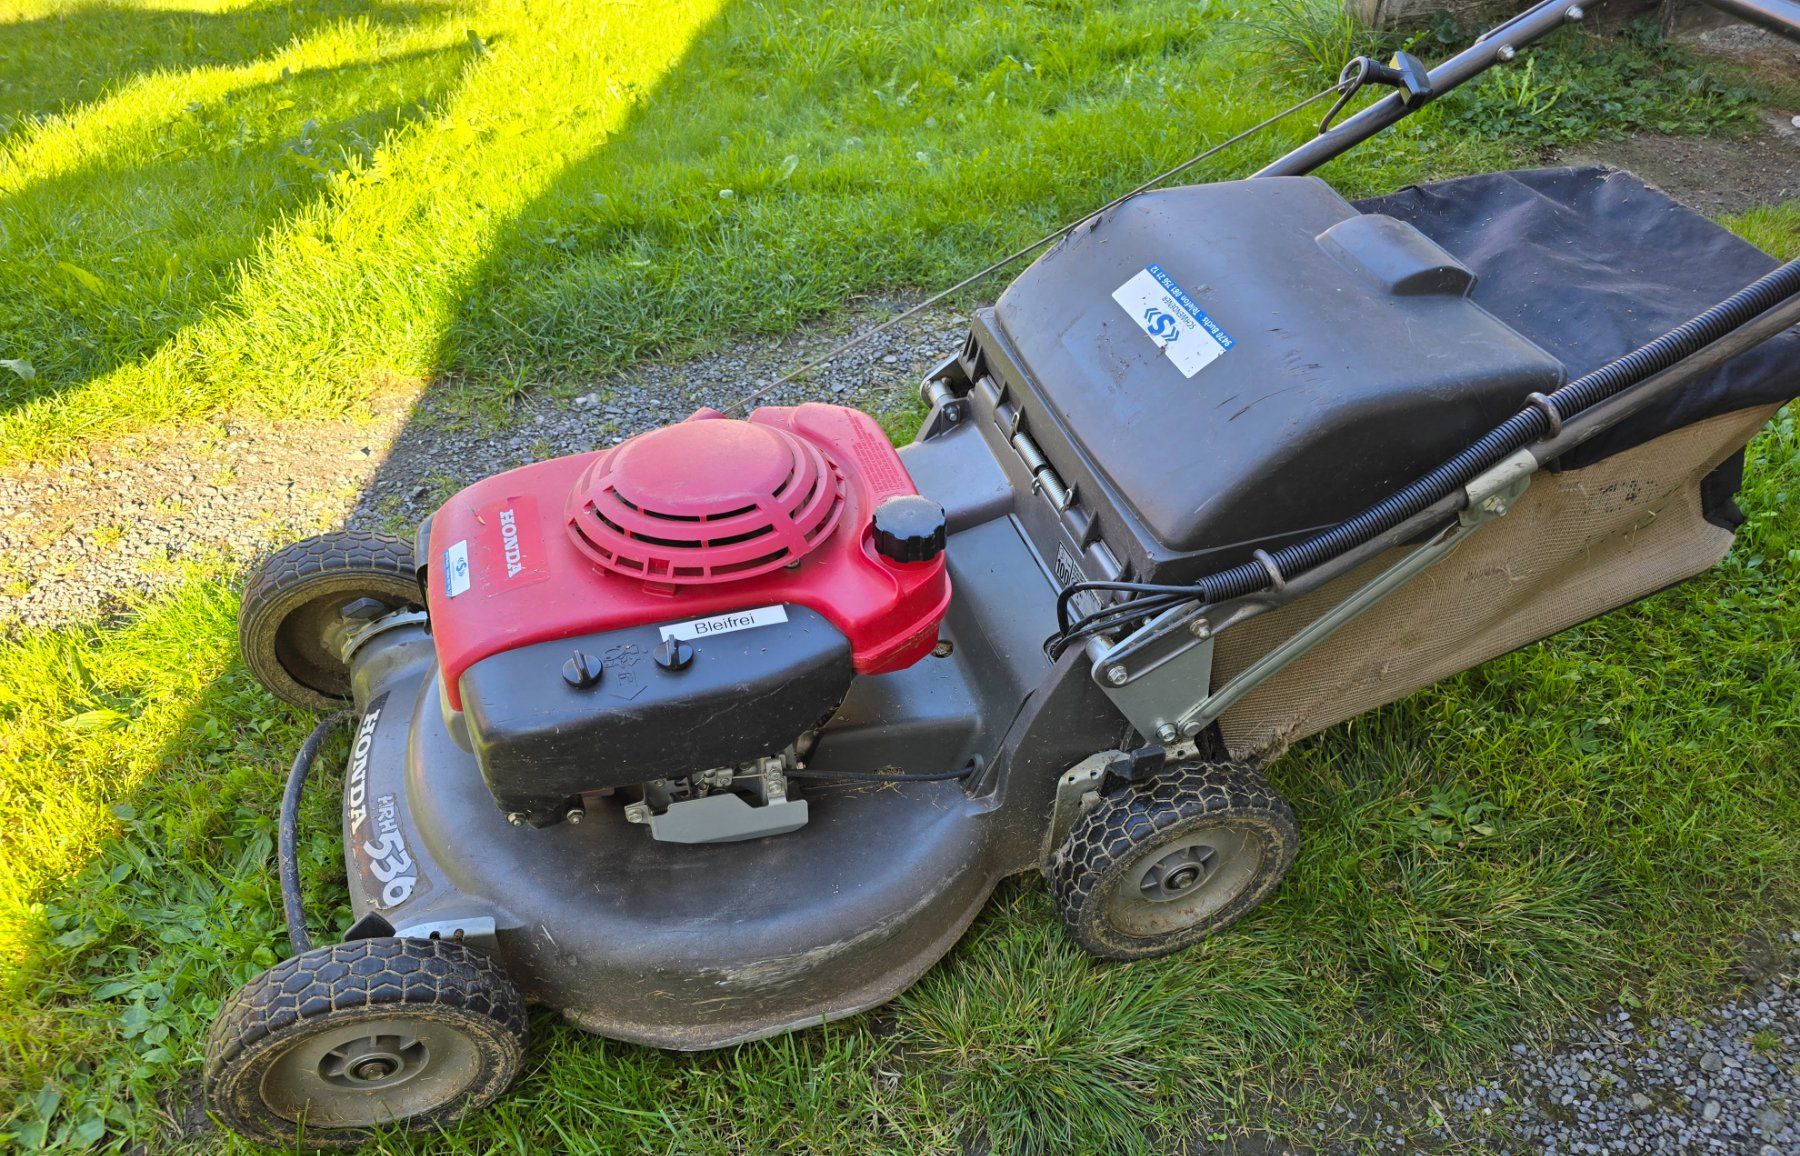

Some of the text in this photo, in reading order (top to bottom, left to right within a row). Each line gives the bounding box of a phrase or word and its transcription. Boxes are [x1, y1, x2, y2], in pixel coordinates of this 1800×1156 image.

[1161, 295, 1197, 330] SCHWENDENER
[1181, 295, 1201, 317] Telefon
[1202, 317, 1220, 334] Buchs
[1215, 333, 1233, 347] 9470
[499, 508, 522, 578] HONDA
[1056, 558, 1071, 586] 100
[695, 612, 756, 635] Bleifrei
[347, 708, 381, 836] HONDA
